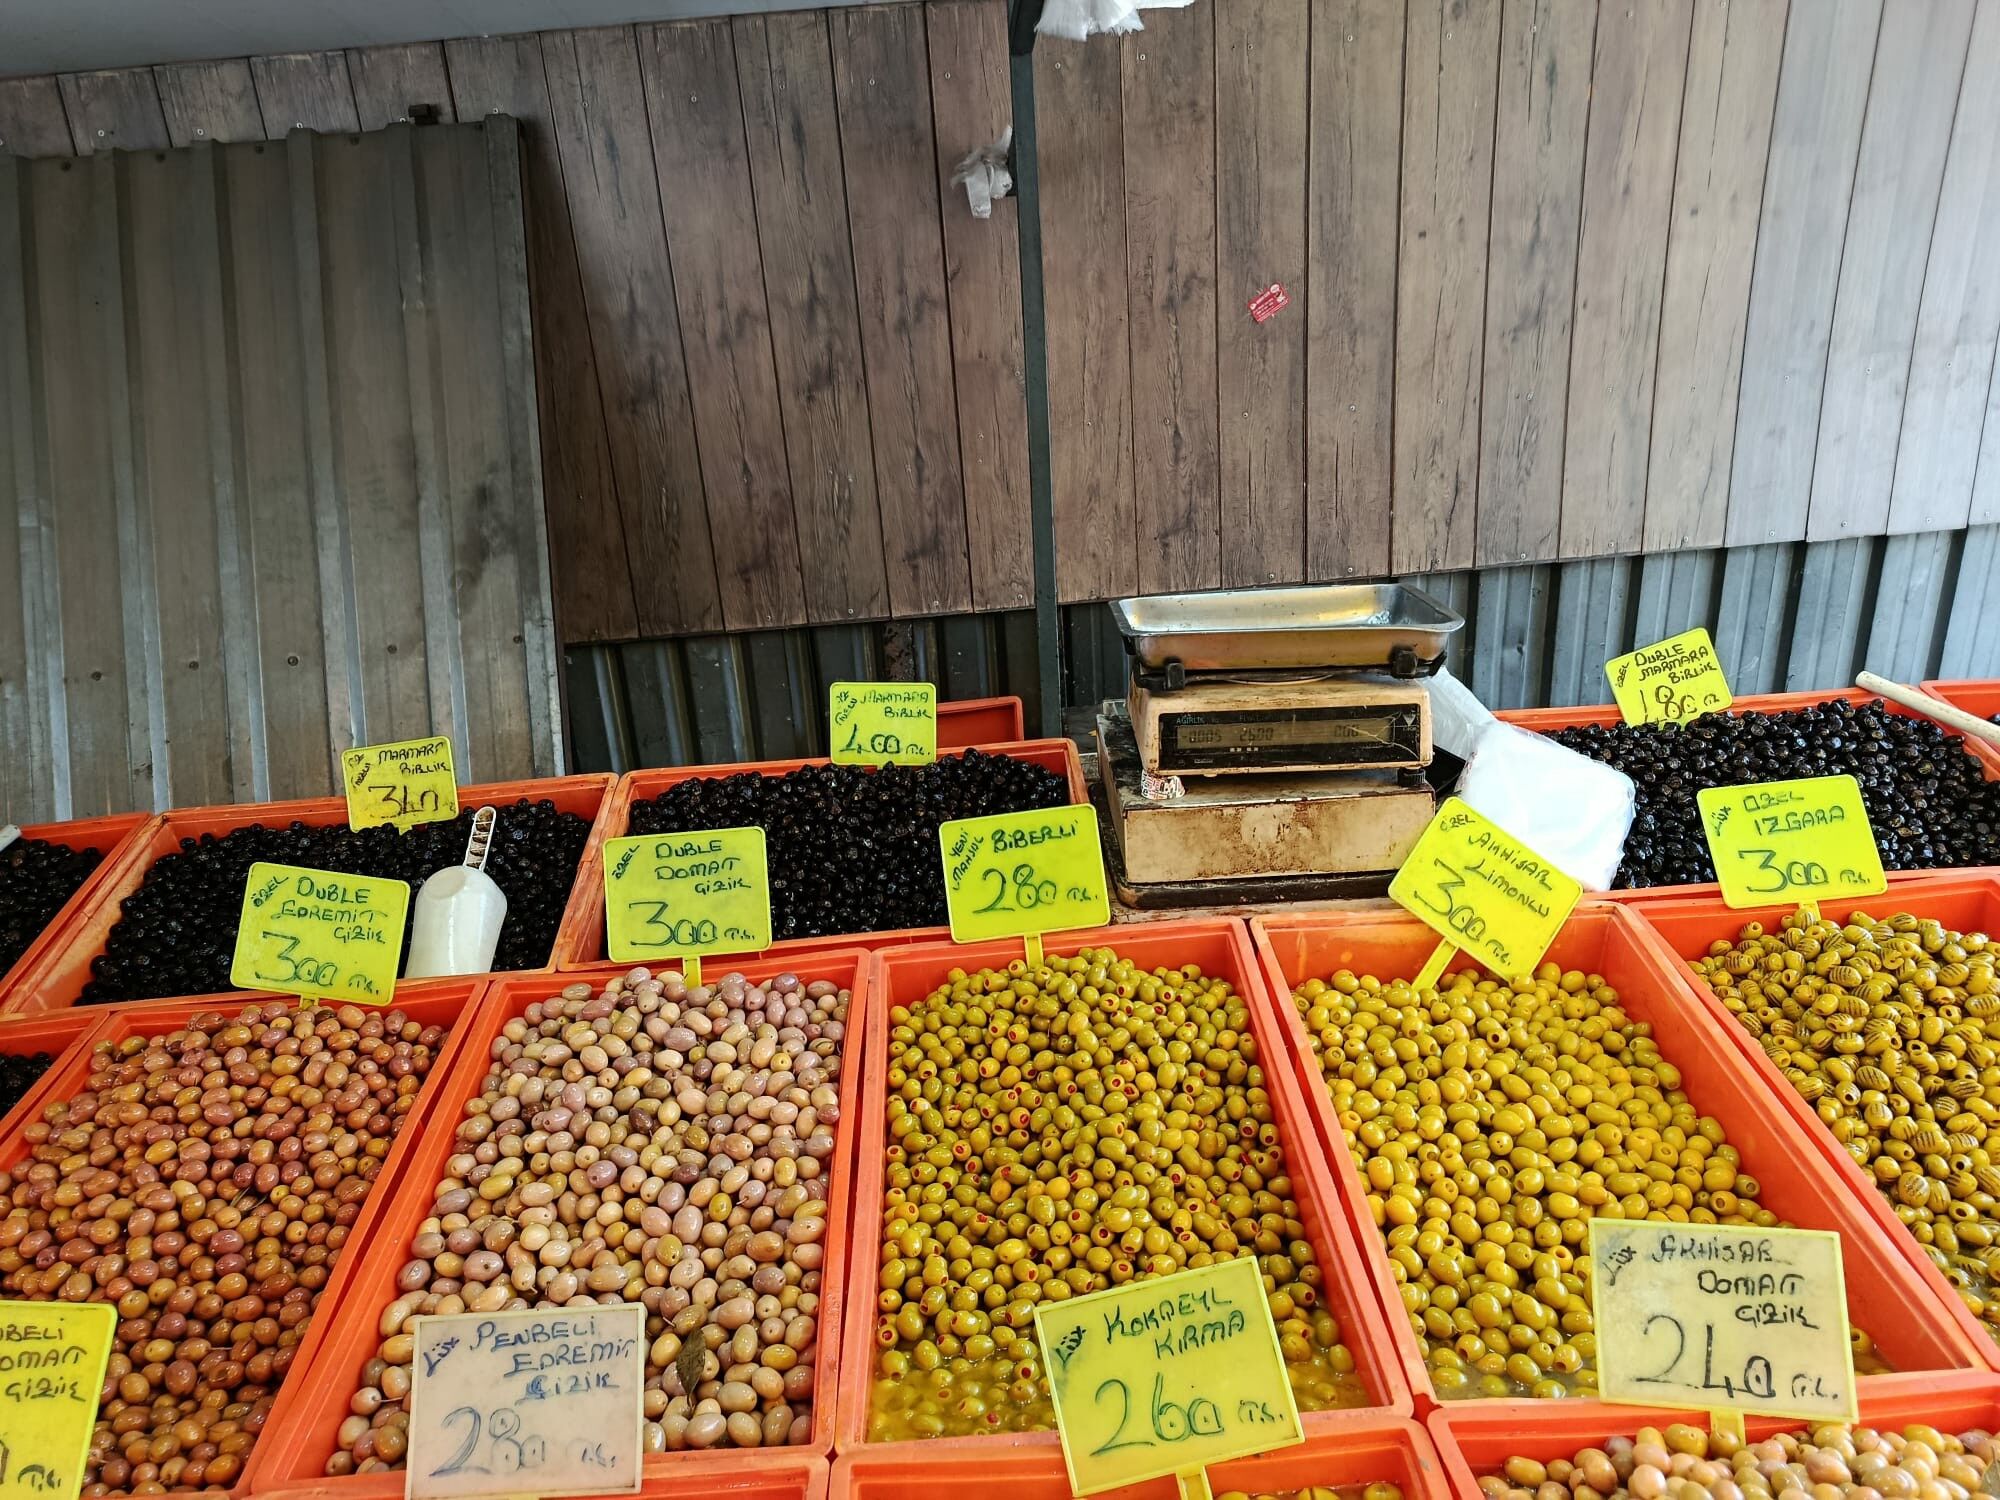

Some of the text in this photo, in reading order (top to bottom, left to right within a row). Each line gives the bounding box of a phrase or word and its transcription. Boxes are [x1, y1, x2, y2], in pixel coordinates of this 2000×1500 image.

[654, 857, 741, 880] DOMAT
[655, 840, 722, 859] DUBLE
[1738, 850, 1829, 893] 300
[296, 876, 371, 904] DUBLE
[972, 863, 1057, 914] 280
[1413, 857, 1486, 942] 300
[628, 901, 718, 946] 300
[255, 930, 338, 987] 300
[1697, 1269, 1804, 1296] DOMAT
[1632, 1314, 1776, 1399] 240
[1089, 1371, 1225, 1457] 260
[428, 1406, 546, 1477] 280
